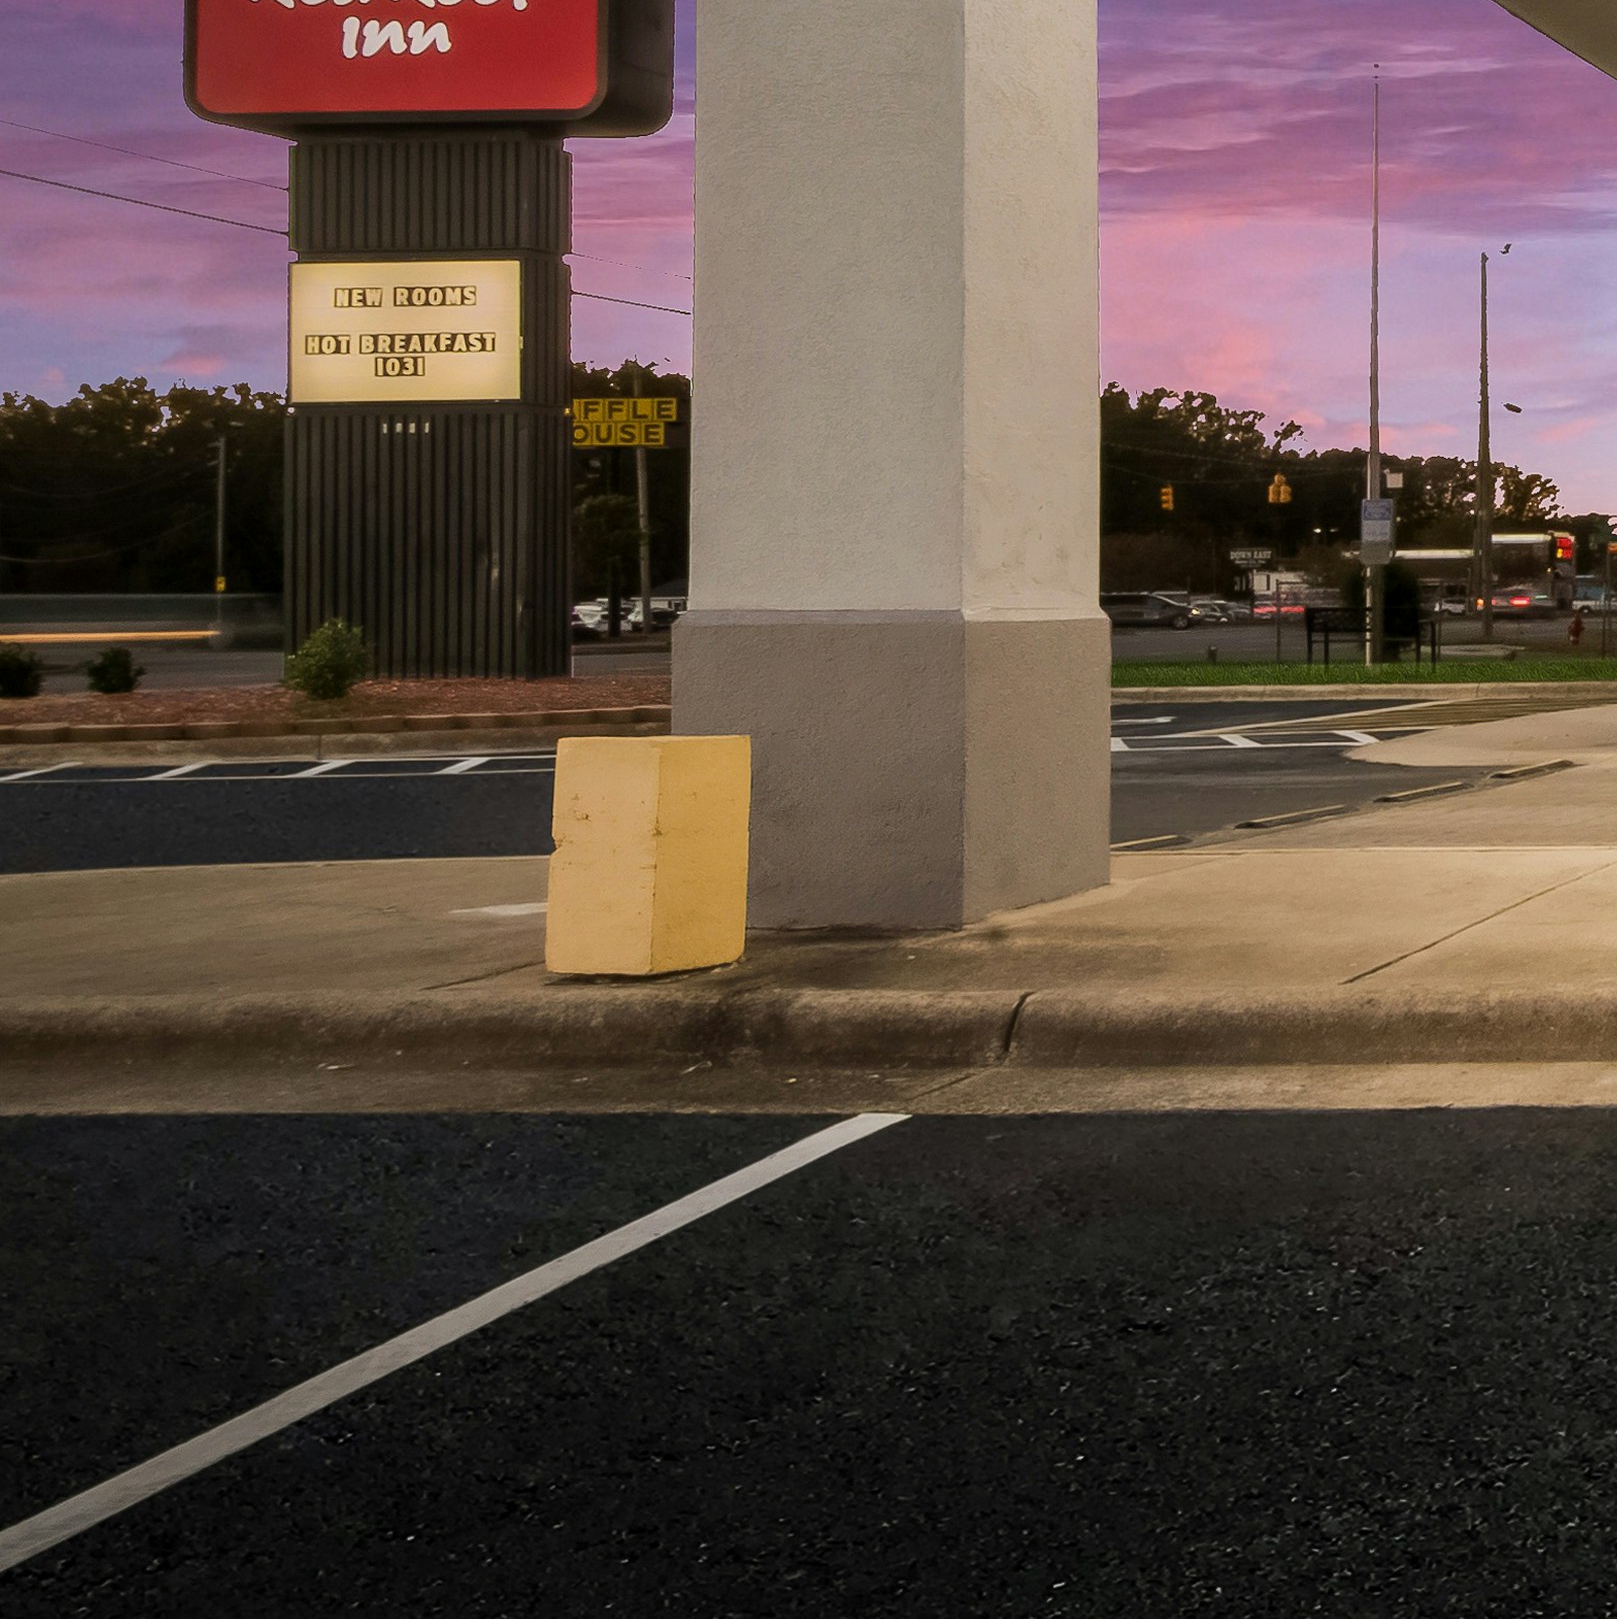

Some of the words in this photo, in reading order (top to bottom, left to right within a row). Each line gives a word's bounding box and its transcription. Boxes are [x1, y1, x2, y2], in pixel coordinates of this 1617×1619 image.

[334, 287, 383, 307] NEW
[394, 285, 477, 307] ROOMS
[305, 334, 351, 355] HOT
[359, 332, 496, 355] BREAKFAST
[375, 356, 425, 376] 1031
[574, 399, 675, 420] FFLE
[573, 424, 661, 443] OUSE
